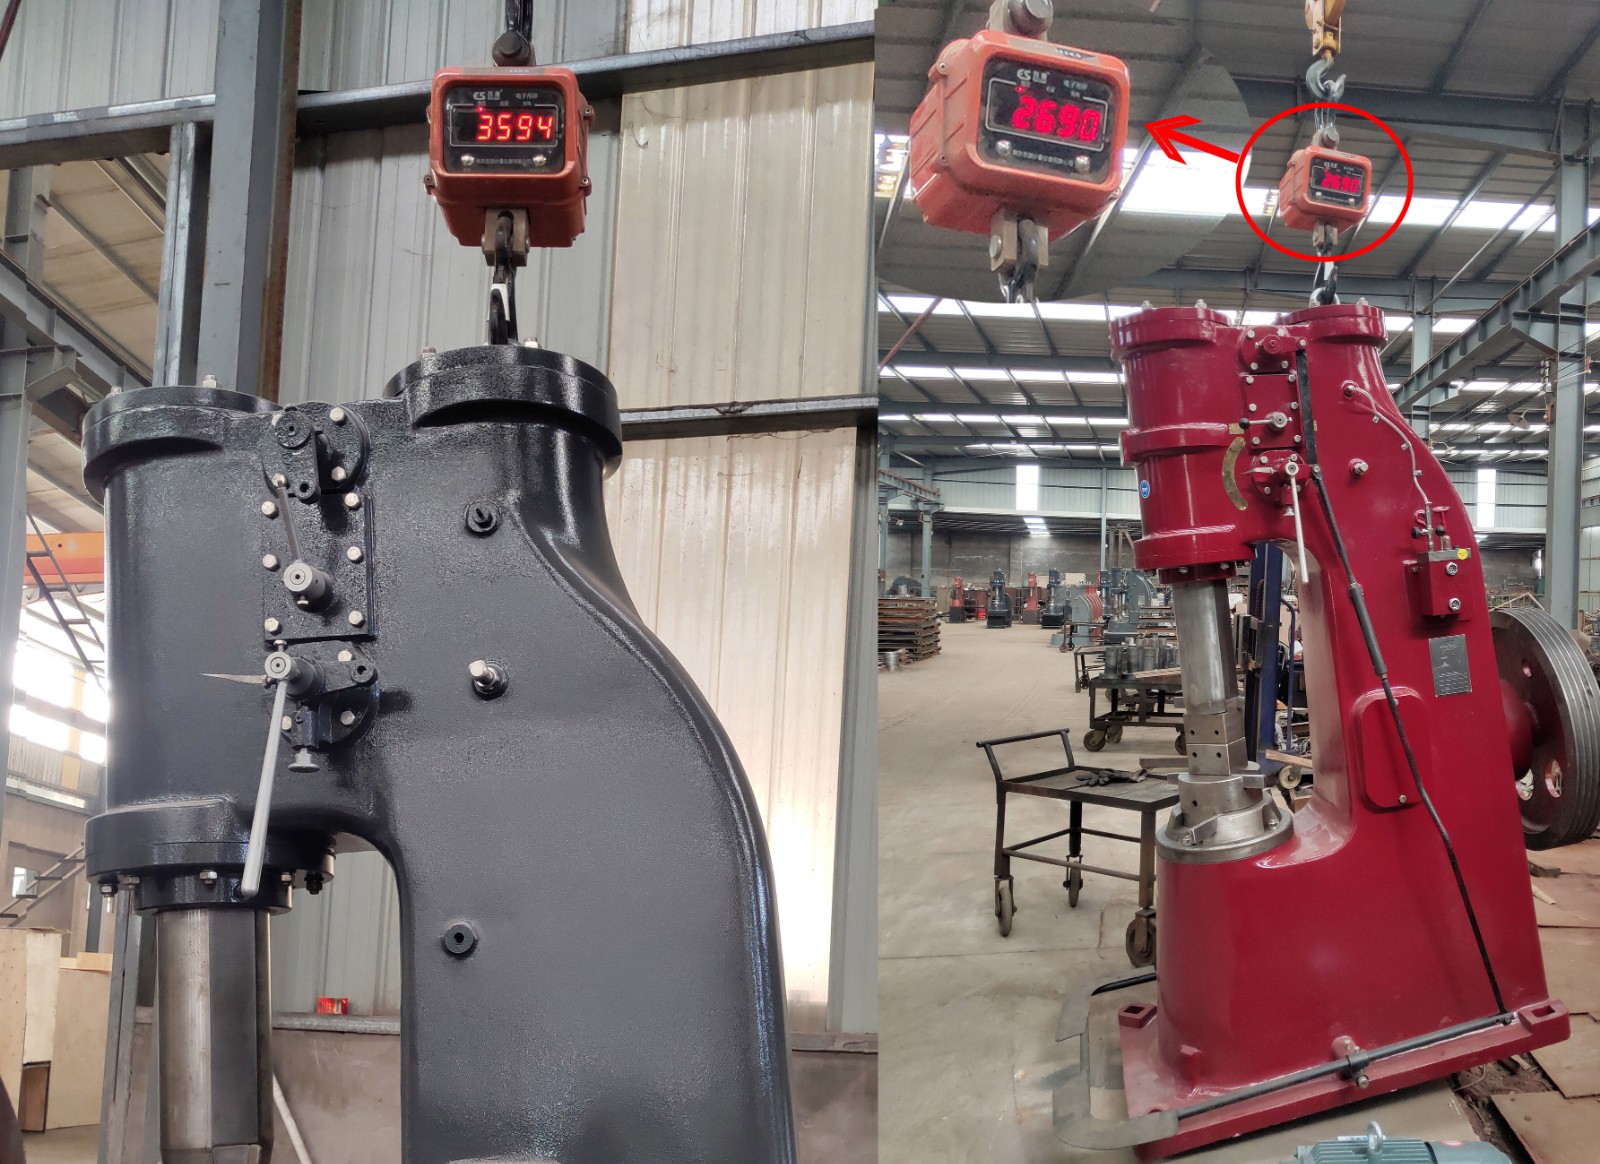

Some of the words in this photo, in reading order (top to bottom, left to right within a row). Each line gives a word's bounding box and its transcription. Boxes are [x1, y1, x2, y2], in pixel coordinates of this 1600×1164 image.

[477, 114, 554, 140] 3594
[1011, 95, 1101, 142] 2690
[1321, 172, 1360, 193] 2690
